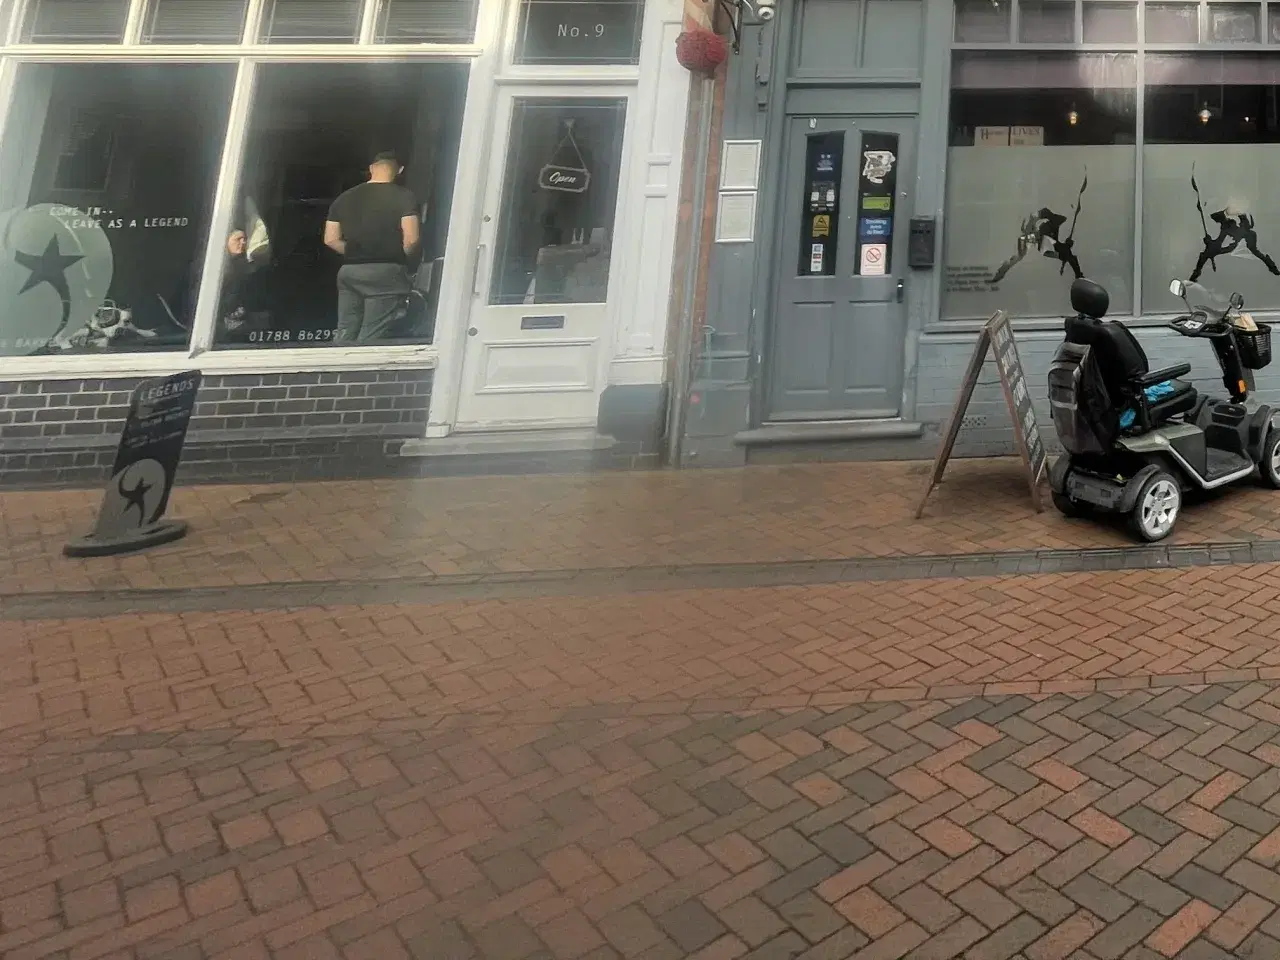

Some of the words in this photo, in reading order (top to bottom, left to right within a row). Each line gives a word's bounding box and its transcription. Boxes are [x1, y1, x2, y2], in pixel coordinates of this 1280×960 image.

[557, 24, 605, 38] No.9
[549, 171, 576, 184] Open
[49, 207, 79, 217] COME
[64, 219, 102, 229] LEAVE
[108, 219, 123, 228] AS
[129, 220, 137, 228] A
[144, 217, 188, 228] LEGEND
[249, 330, 291, 342] 01788
[141, 380, 194, 401] LEGENDS
